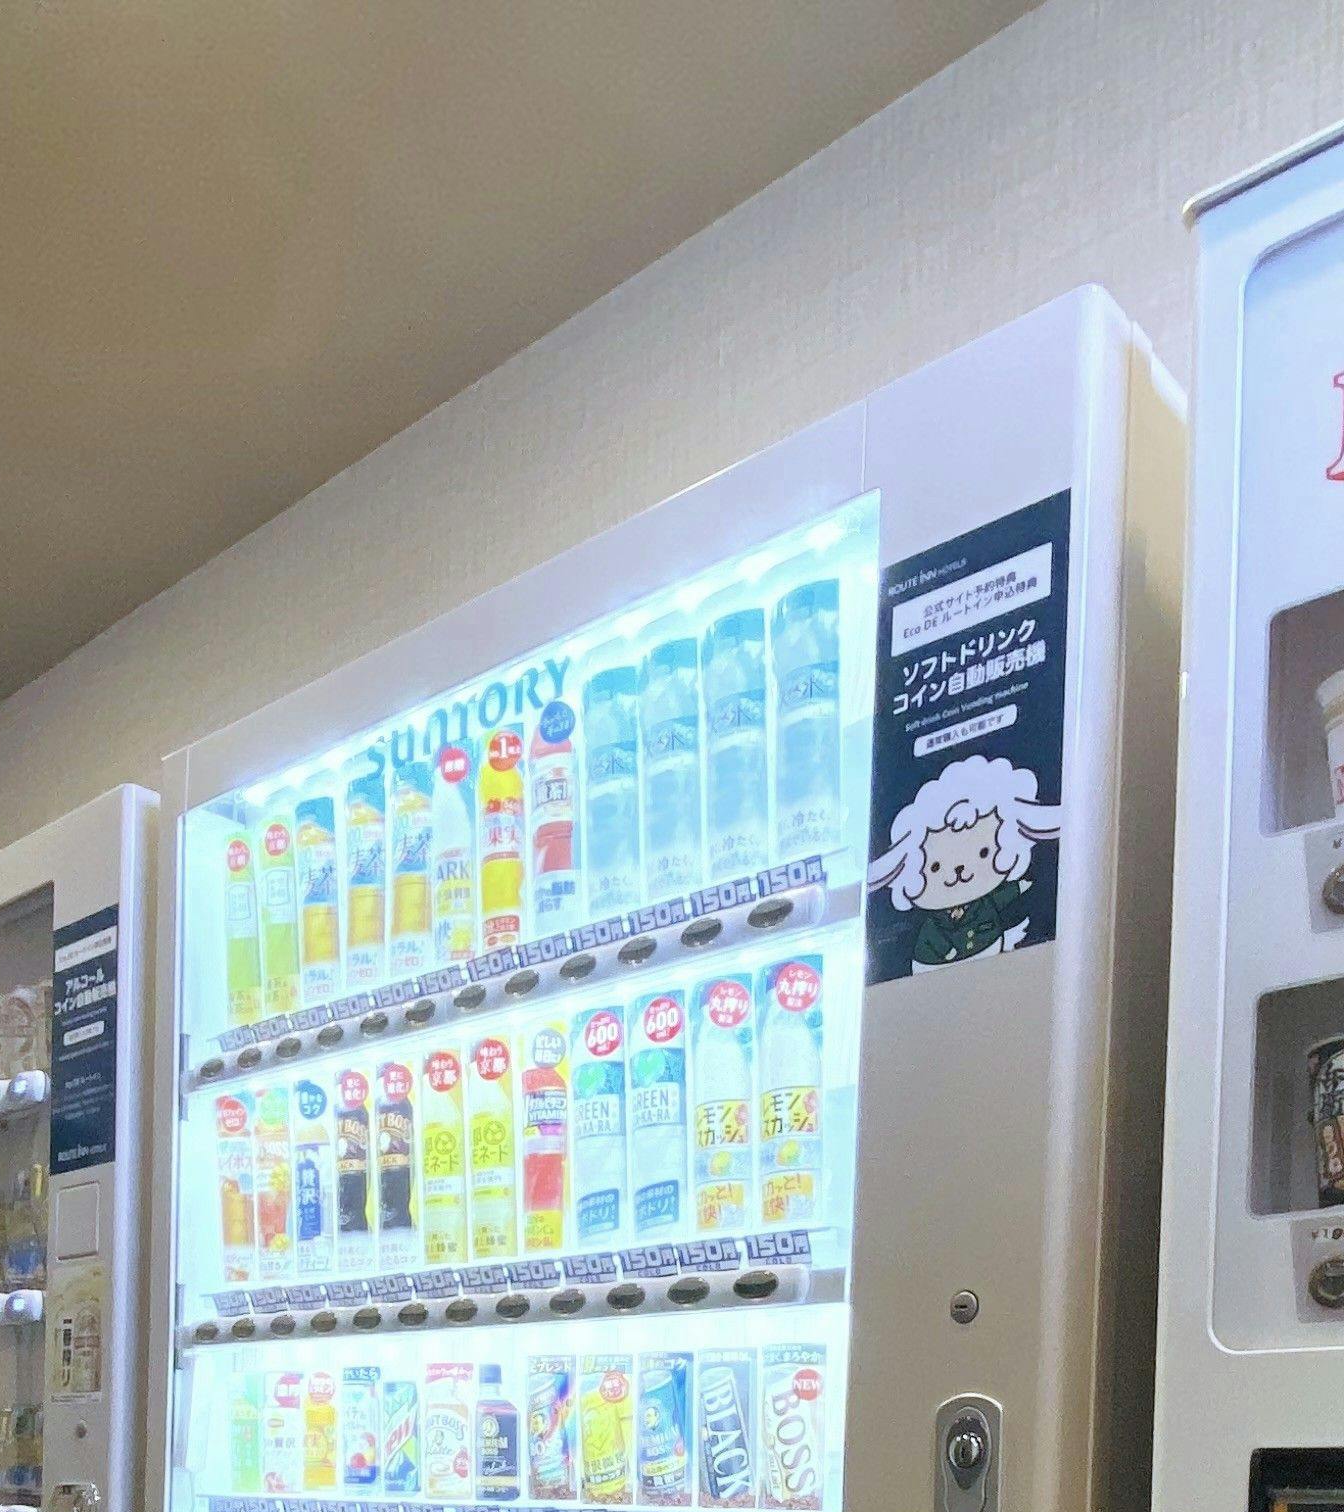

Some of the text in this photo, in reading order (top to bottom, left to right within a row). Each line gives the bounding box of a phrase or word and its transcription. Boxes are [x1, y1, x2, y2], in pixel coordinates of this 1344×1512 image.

[903, 619, 1037, 686] ソフトドリンク
[892, 639, 1047, 715] コイン自動販売機
[760, 860, 822, 896] 150円
[587, 1025, 619, 1047] 600
[646, 1012, 679, 1034] 600
[680, 1241, 737, 1265] 150円
[749, 1233, 809, 1258] 150円
[794, 1379, 822, 1391] NEW
[703, 1382, 754, 1499] BLACK
[772, 1388, 817, 1494] BOSS
